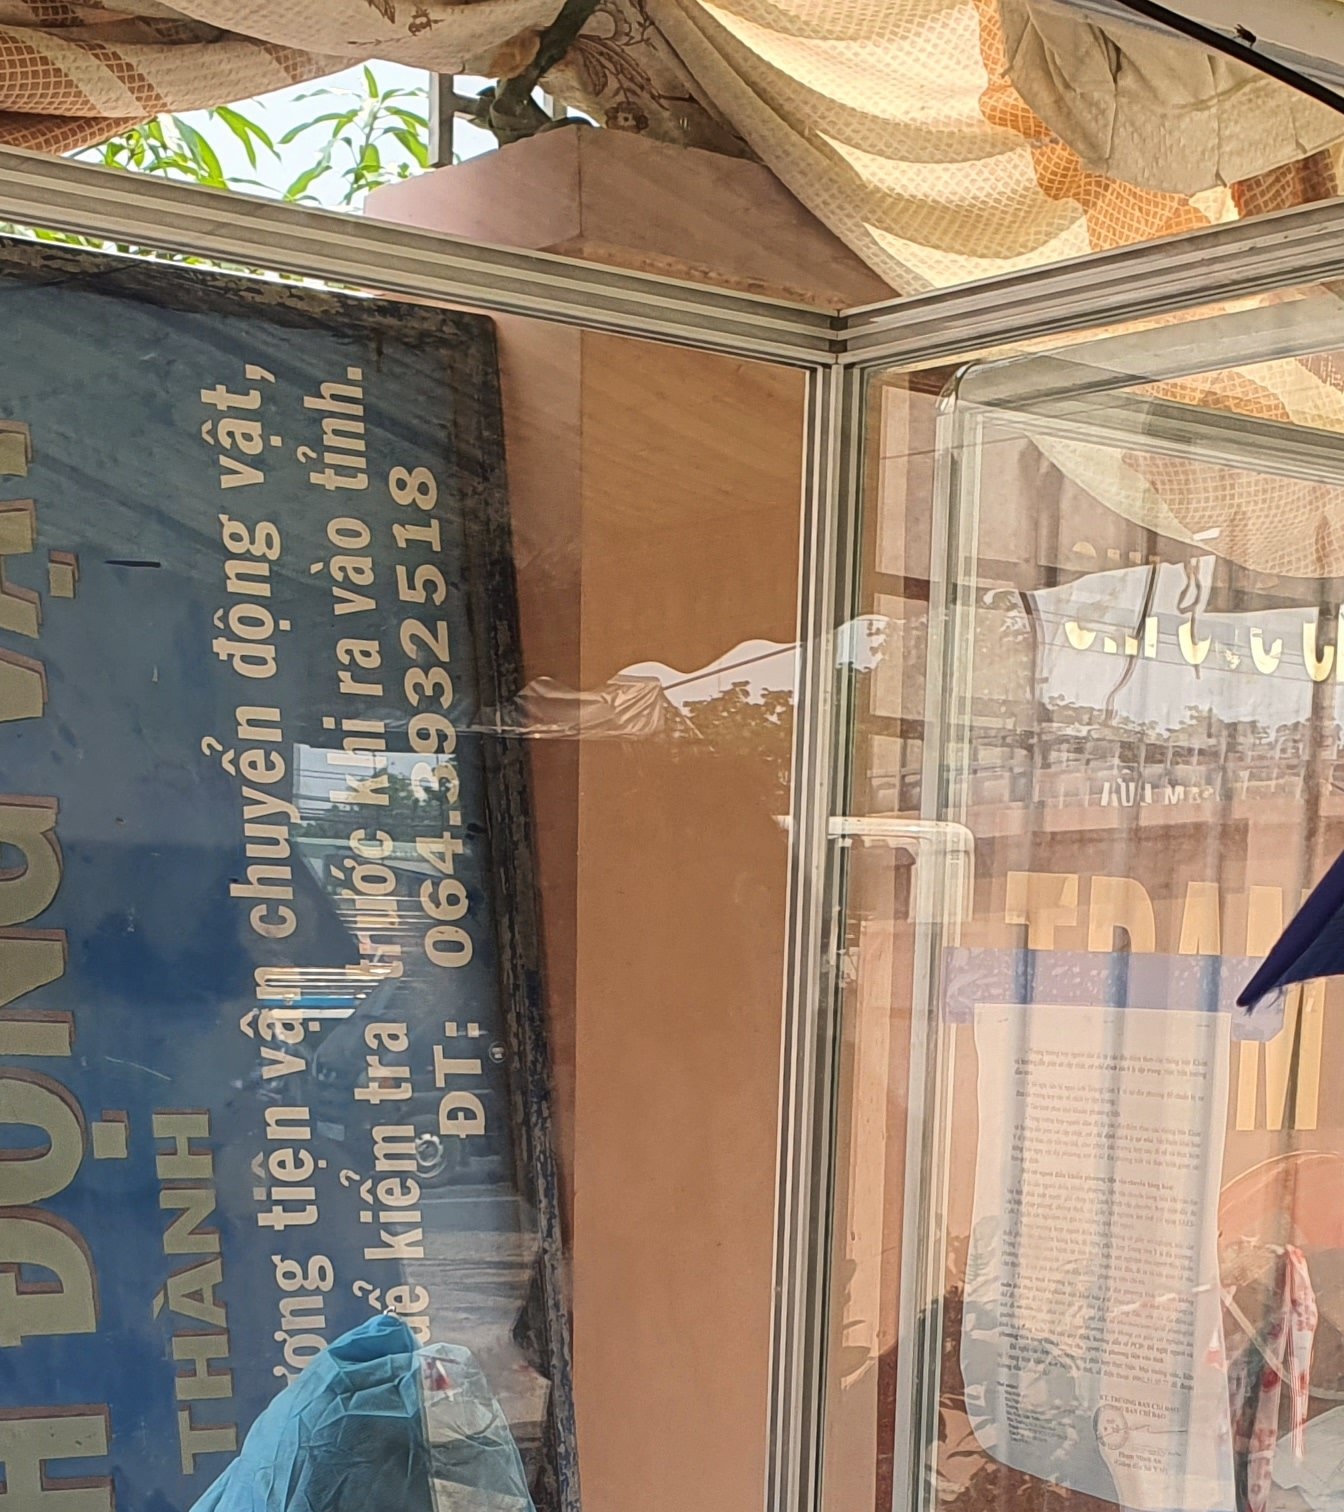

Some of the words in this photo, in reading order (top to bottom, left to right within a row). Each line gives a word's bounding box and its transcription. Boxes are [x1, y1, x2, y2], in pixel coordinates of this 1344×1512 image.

[200, 362, 282, 489] vật,
[212, 514, 292, 678] động
[310, 516, 376, 615] vào
[334, 637, 381, 695] ra
[201, 706, 301, 939] chuyển
[322, 716, 391, 808] khi
[334, 829, 403, 978] trước
[241, 965, 322, 1080] vận
[354, 1021, 409, 1105] tra
[434, 1021, 486, 1139] ĐT:
[253, 1105, 328, 1231] tiện
[338, 1123, 425, 1261] kiểm
[152, 1109, 239, 1474] THÀNH
